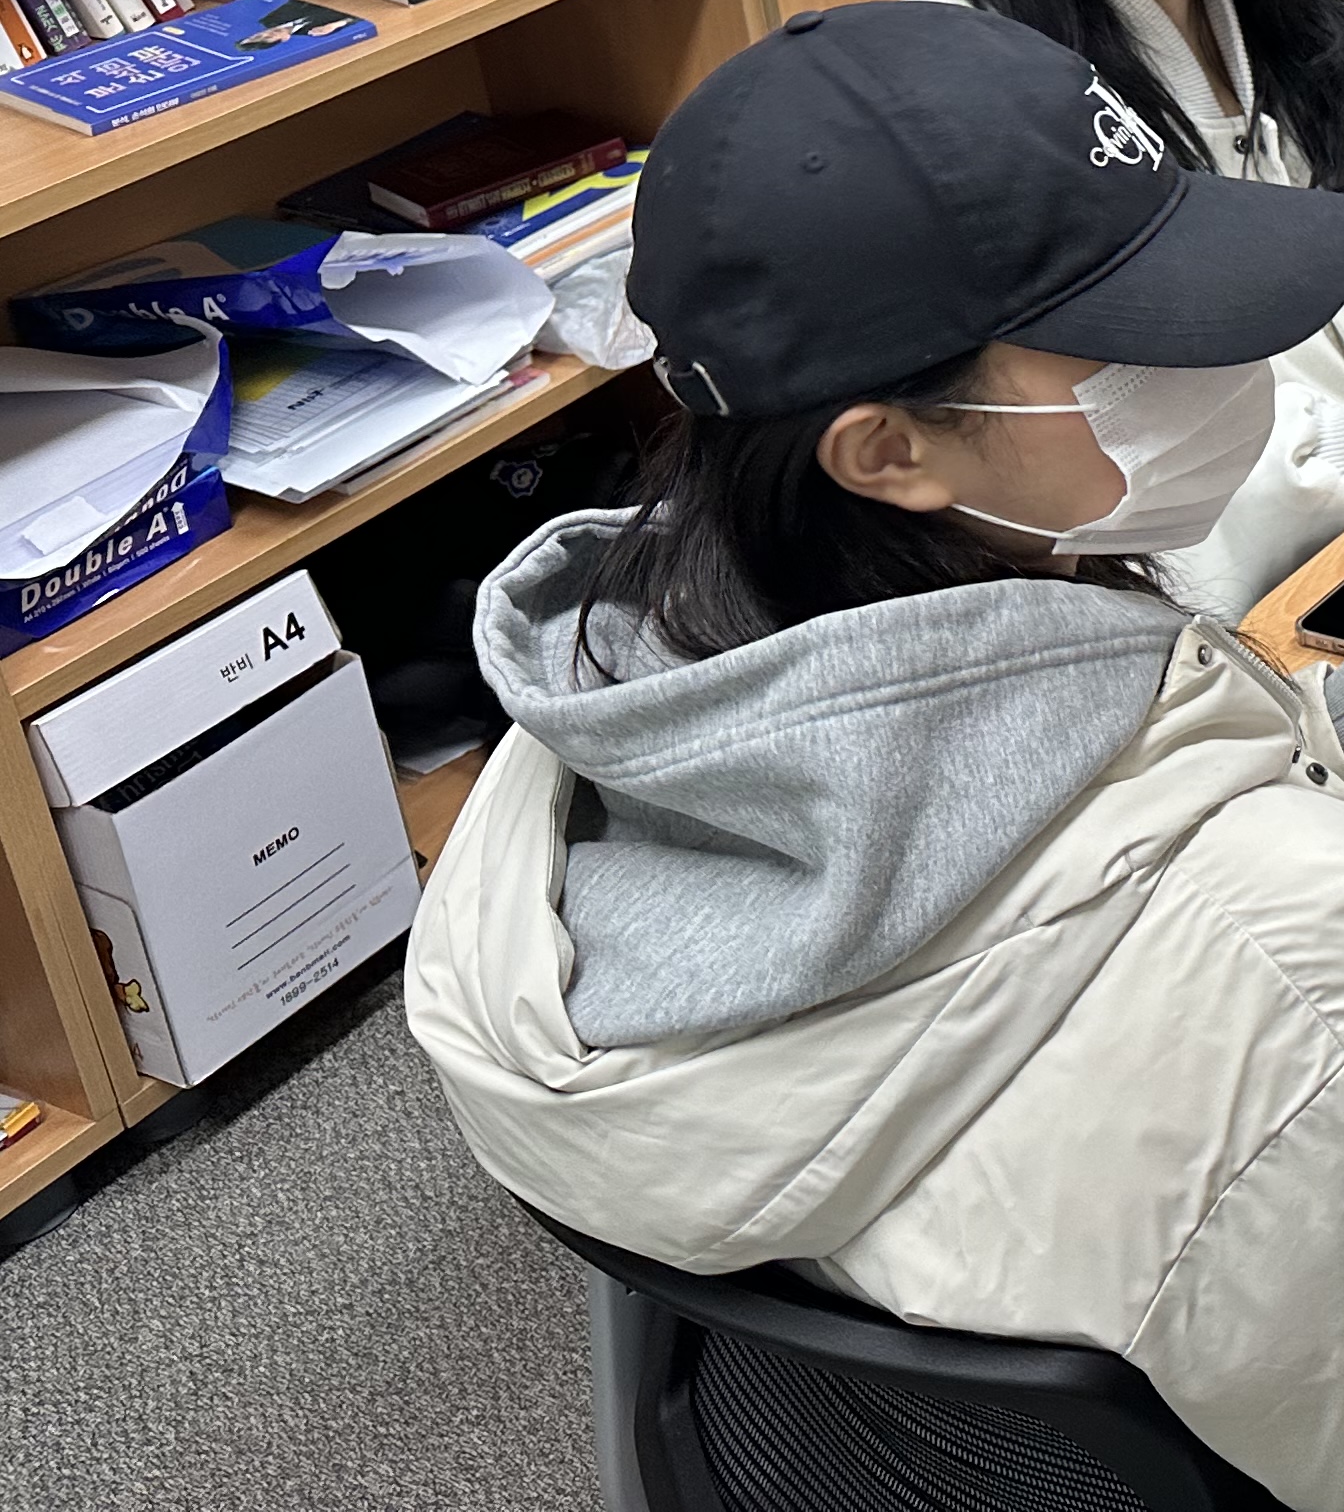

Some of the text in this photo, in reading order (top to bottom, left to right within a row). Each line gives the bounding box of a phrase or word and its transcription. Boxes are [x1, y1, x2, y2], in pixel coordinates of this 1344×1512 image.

[21, 511, 168, 614] Double A
[219, 611, 307, 683] 반비 A4
[252, 826, 301, 868] MEMO
